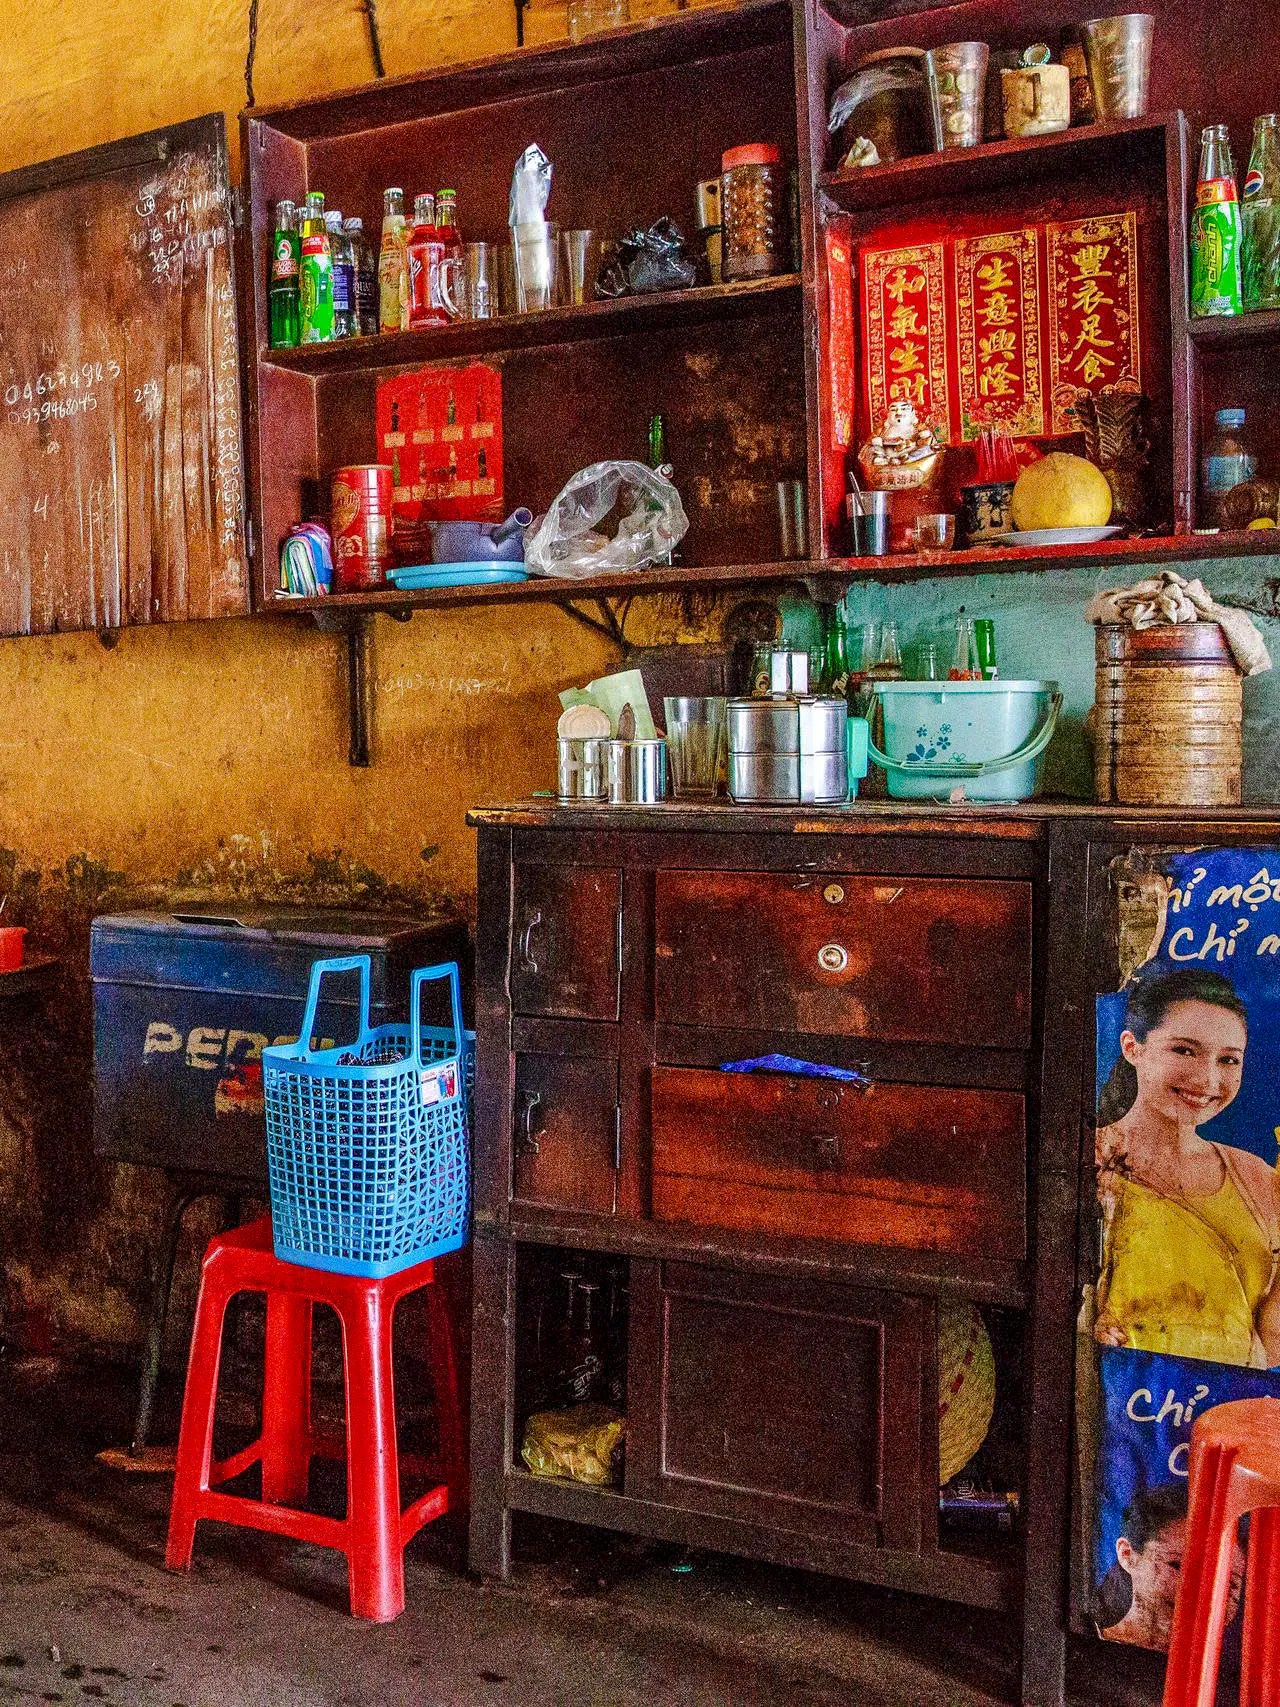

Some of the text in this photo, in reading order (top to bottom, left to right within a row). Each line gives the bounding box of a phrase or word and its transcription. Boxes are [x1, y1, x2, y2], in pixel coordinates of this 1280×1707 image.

[886, 267, 928, 405] 和氣生財
[976, 256, 1021, 397] 生意興隆
[1169, 918, 1250, 962] Chỉ
[1126, 1385, 1210, 1427] Chỉ
